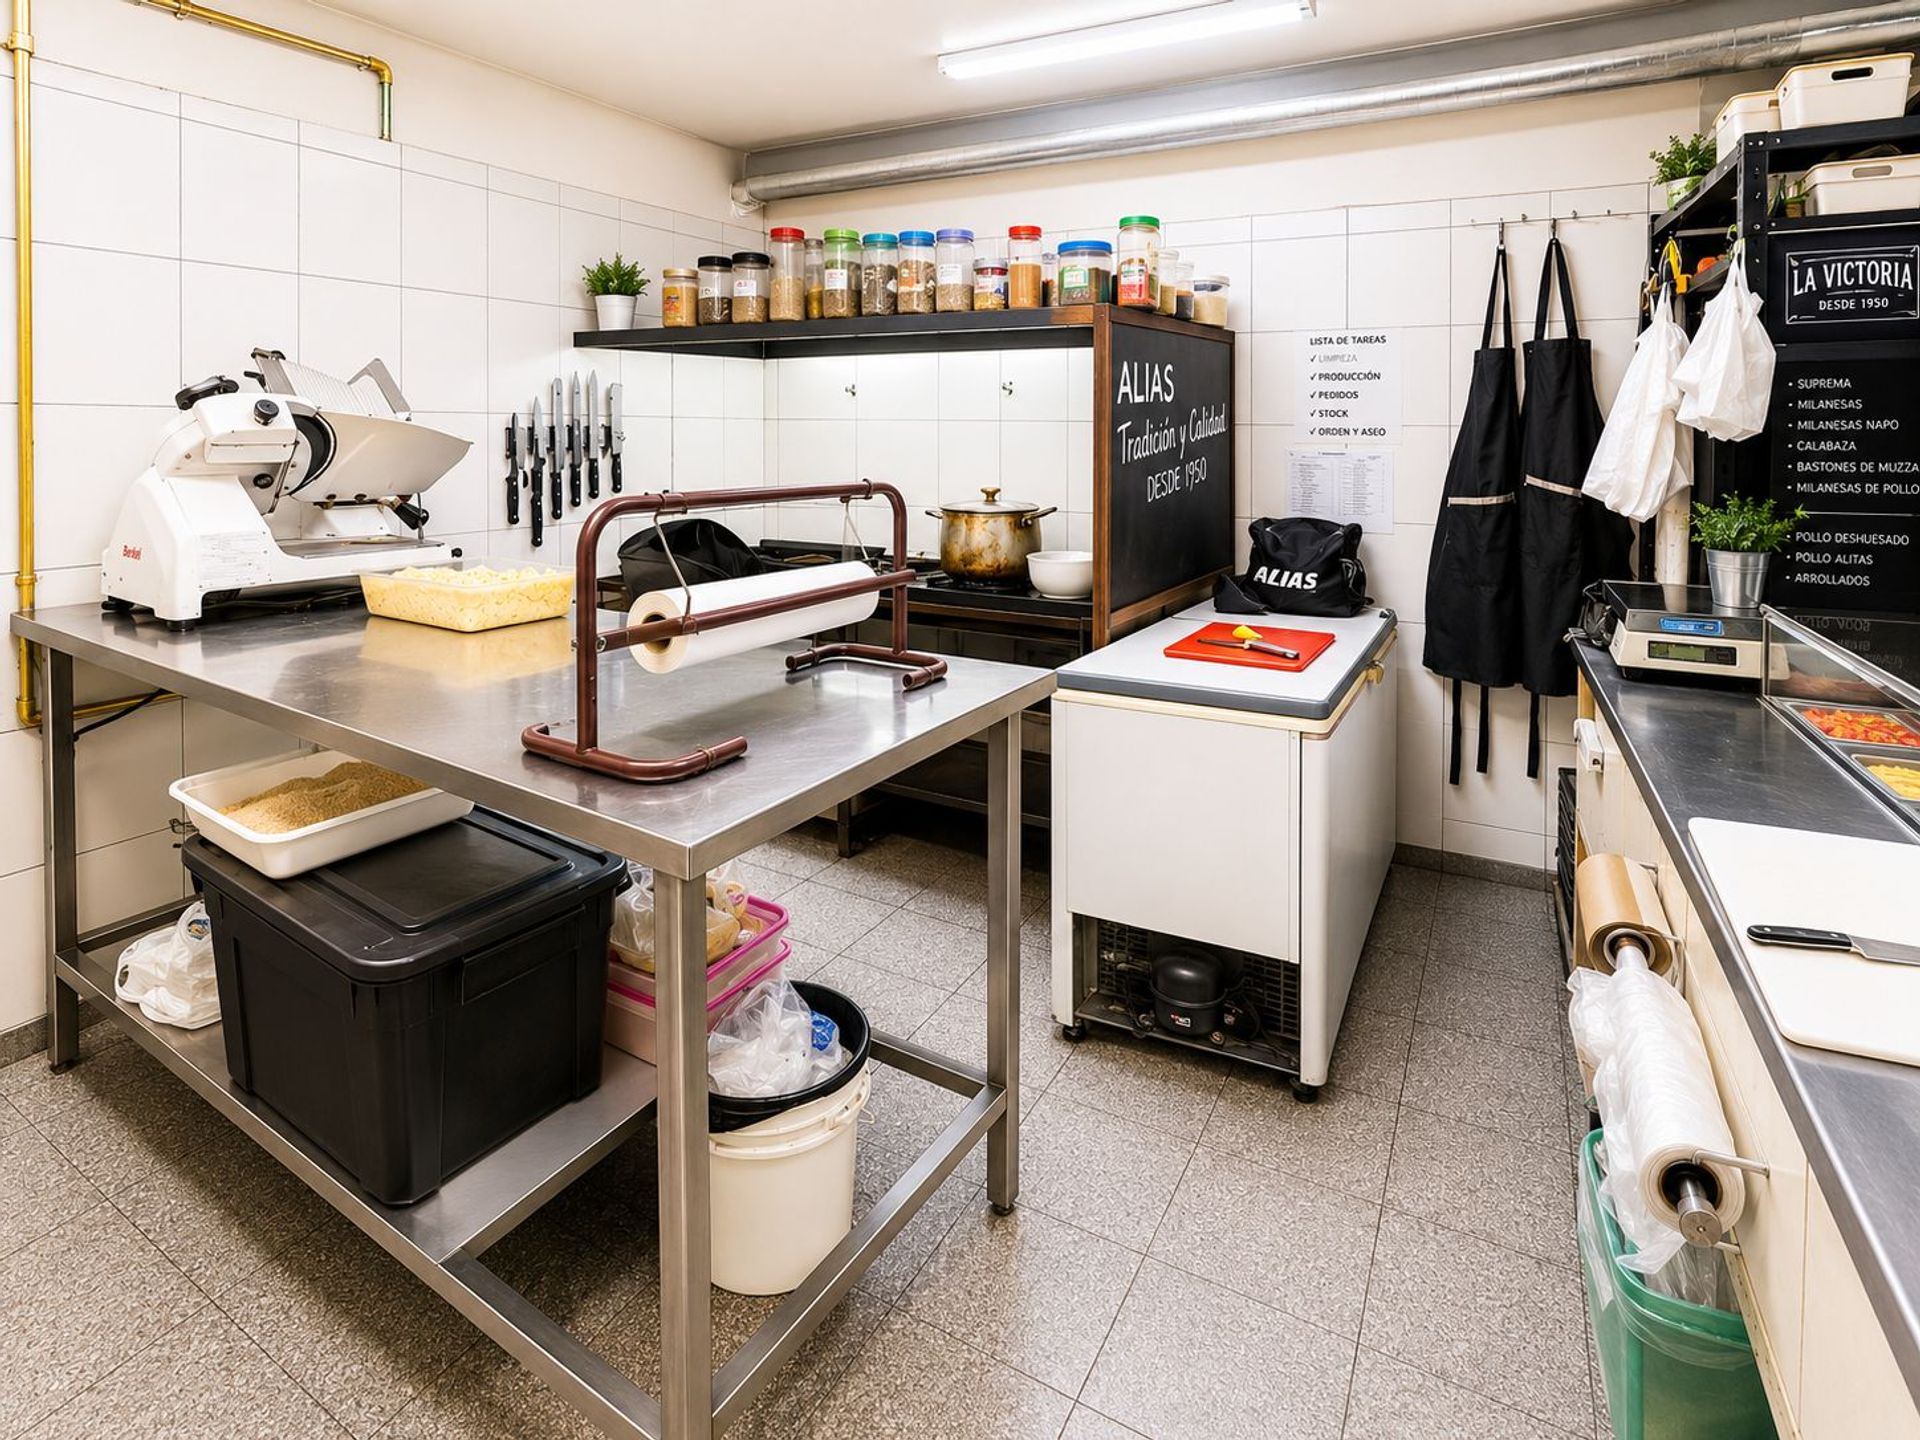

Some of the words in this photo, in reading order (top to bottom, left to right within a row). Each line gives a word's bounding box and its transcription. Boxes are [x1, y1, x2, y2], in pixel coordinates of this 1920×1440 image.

[1793, 267, 1817, 296] LA
[1823, 260, 1914, 291] VICTORIA
[1819, 299, 1856, 311] DESDE
[1310, 337, 1334, 345] LISTA
[1336, 336, 1349, 345] DE
[1351, 335, 1387, 344] TAREAS
[1318, 370, 1381, 381] PRODUCCIÓN
[1117, 361, 1174, 404] ALIAS
[1797, 378, 1852, 389] SUPREMA
[1318, 391, 1359, 399] PEDIDOS
[1797, 399, 1863, 410] MILANESAS
[1318, 409, 1349, 418] STOCK
[1797, 420, 1863, 430] MILANESAS
[1866, 419, 1899, 430] NAPO
[1117, 416, 1176, 464] Tradición
[1180, 424, 1187, 459] y
[1189, 403, 1226, 442] Calidad
[1318, 427, 1350, 436] ORDEN
[1352, 427, 1359, 436] Y
[1361, 427, 1386, 436] ASEO
[1796, 440, 1857, 451] CALABAZA
[1796, 461, 1857, 473] BASTONES
[1860, 462, 1875, 473] DE
[1878, 462, 1920, 473] MUZZA
[1147, 466, 1181, 502] DESDE
[1185, 456, 1207, 492] 1950
[1796, 483, 1862, 494] MILANESAS
[1865, 483, 1880, 494] DE
[1883, 483, 1920, 495] POLLO
[1795, 532, 1832, 543] POLLO
[1834, 533, 1910, 545] DESHUESADO
[1795, 552, 1832, 563] POLLO
[1834, 554, 1874, 565] ALITAS
[1253, 566, 1318, 590] ALIAS
[1794, 573, 1871, 586] ARROLLADOS
